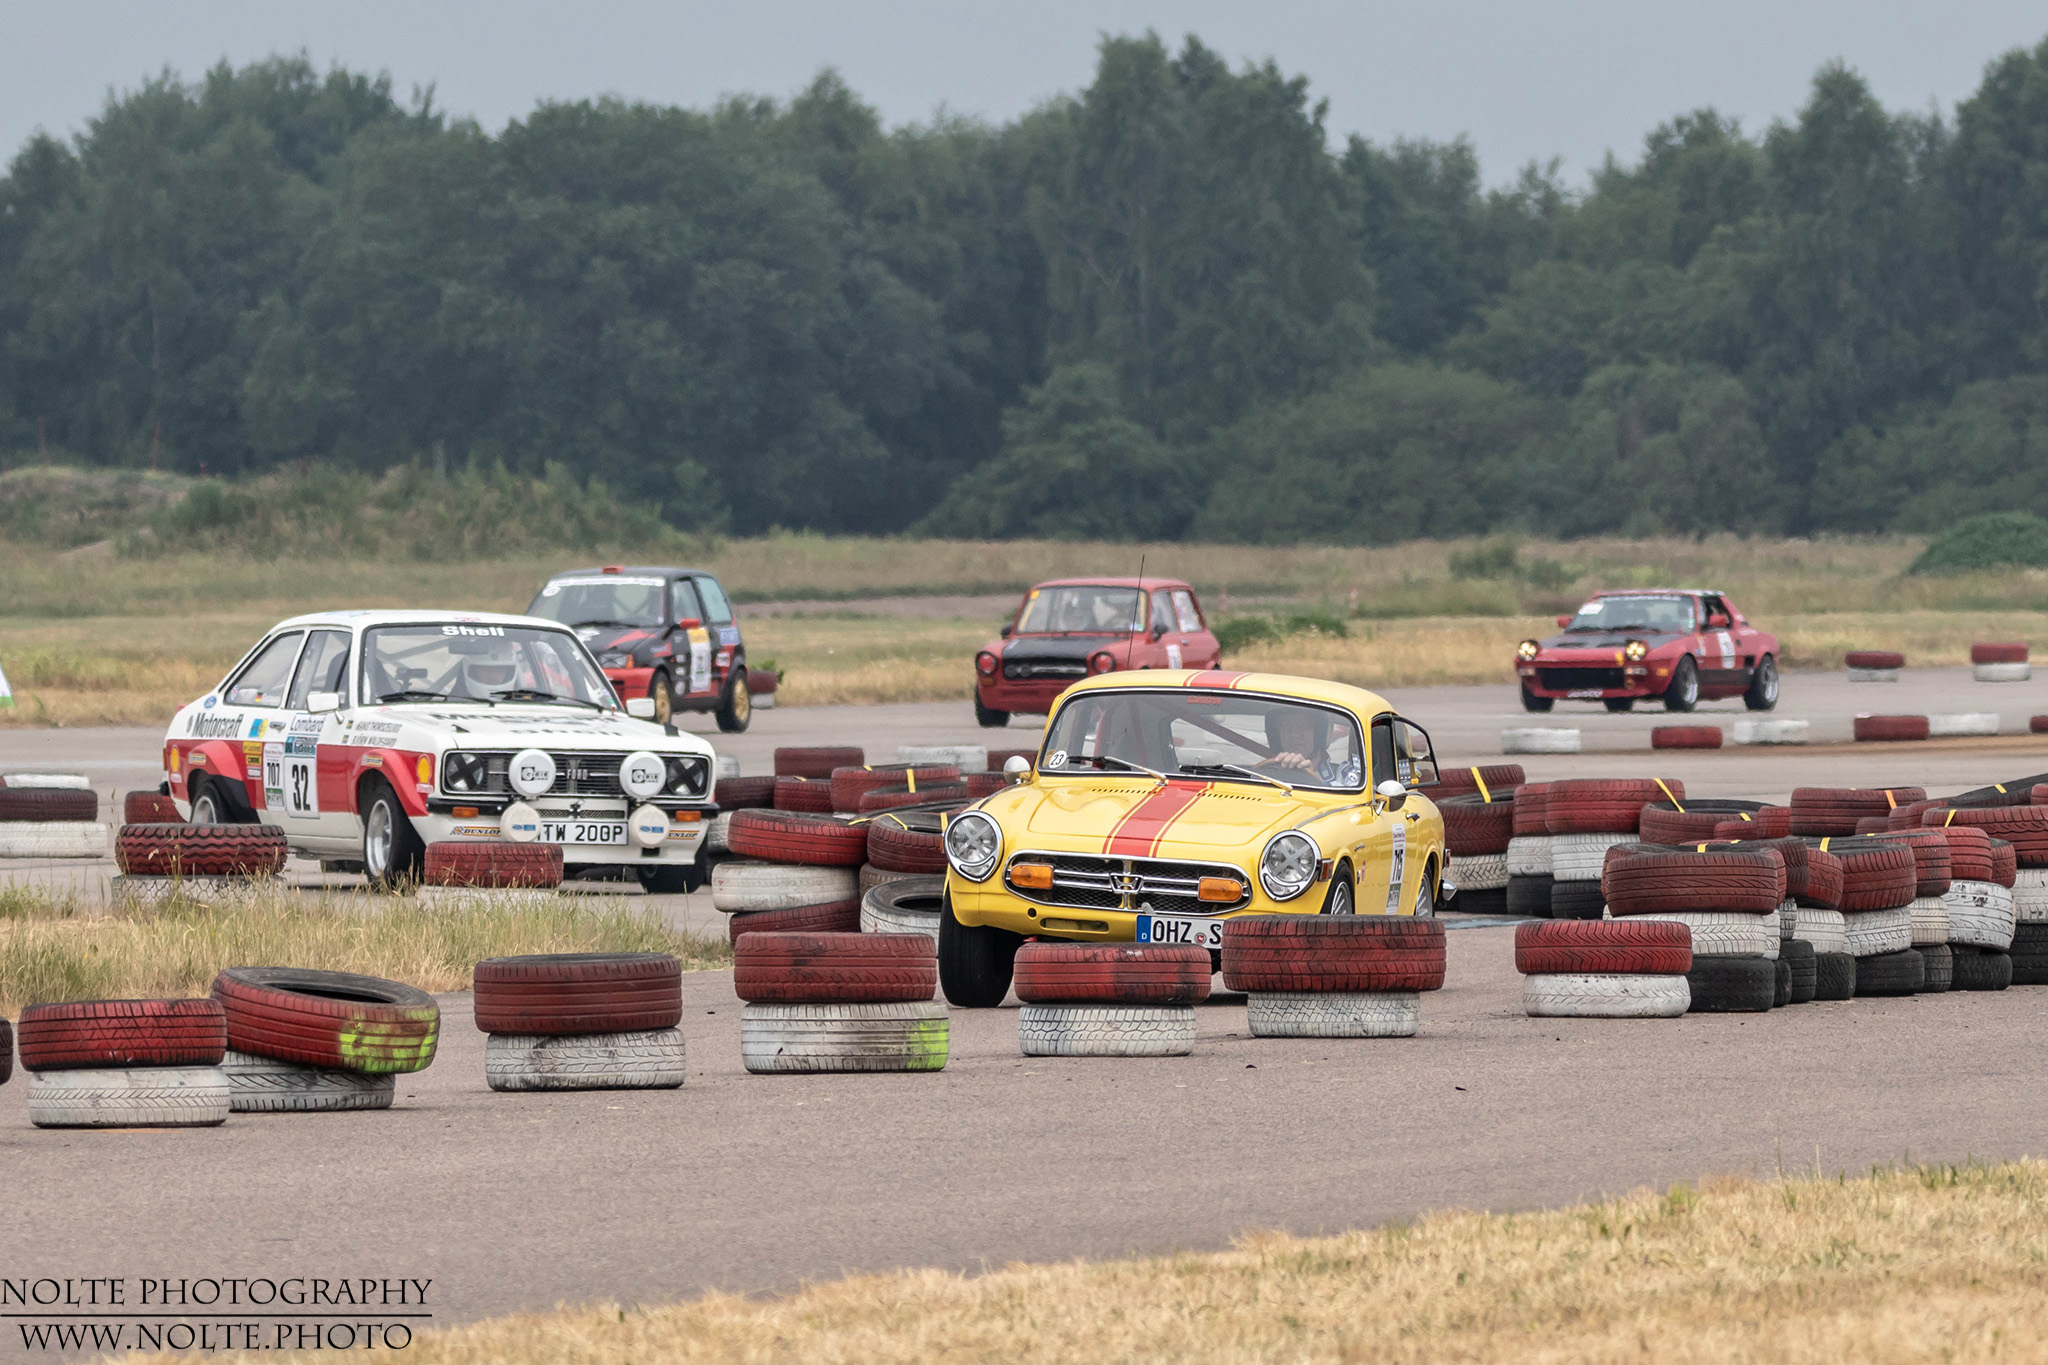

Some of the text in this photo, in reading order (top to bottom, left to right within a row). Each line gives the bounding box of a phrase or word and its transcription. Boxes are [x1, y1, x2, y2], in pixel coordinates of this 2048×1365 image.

[441, 624, 505, 637] Shell
[1187, 695, 1224, 705] Castrol
[192, 712, 244, 738] Motorcraft
[290, 715, 326, 733] Lombard
[1050, 753, 1065, 766] 23
[267, 762, 280, 787] 707
[567, 769, 588, 780] FORD
[292, 764, 311, 811] 32
[1153, 920, 1192, 944] OHZ
